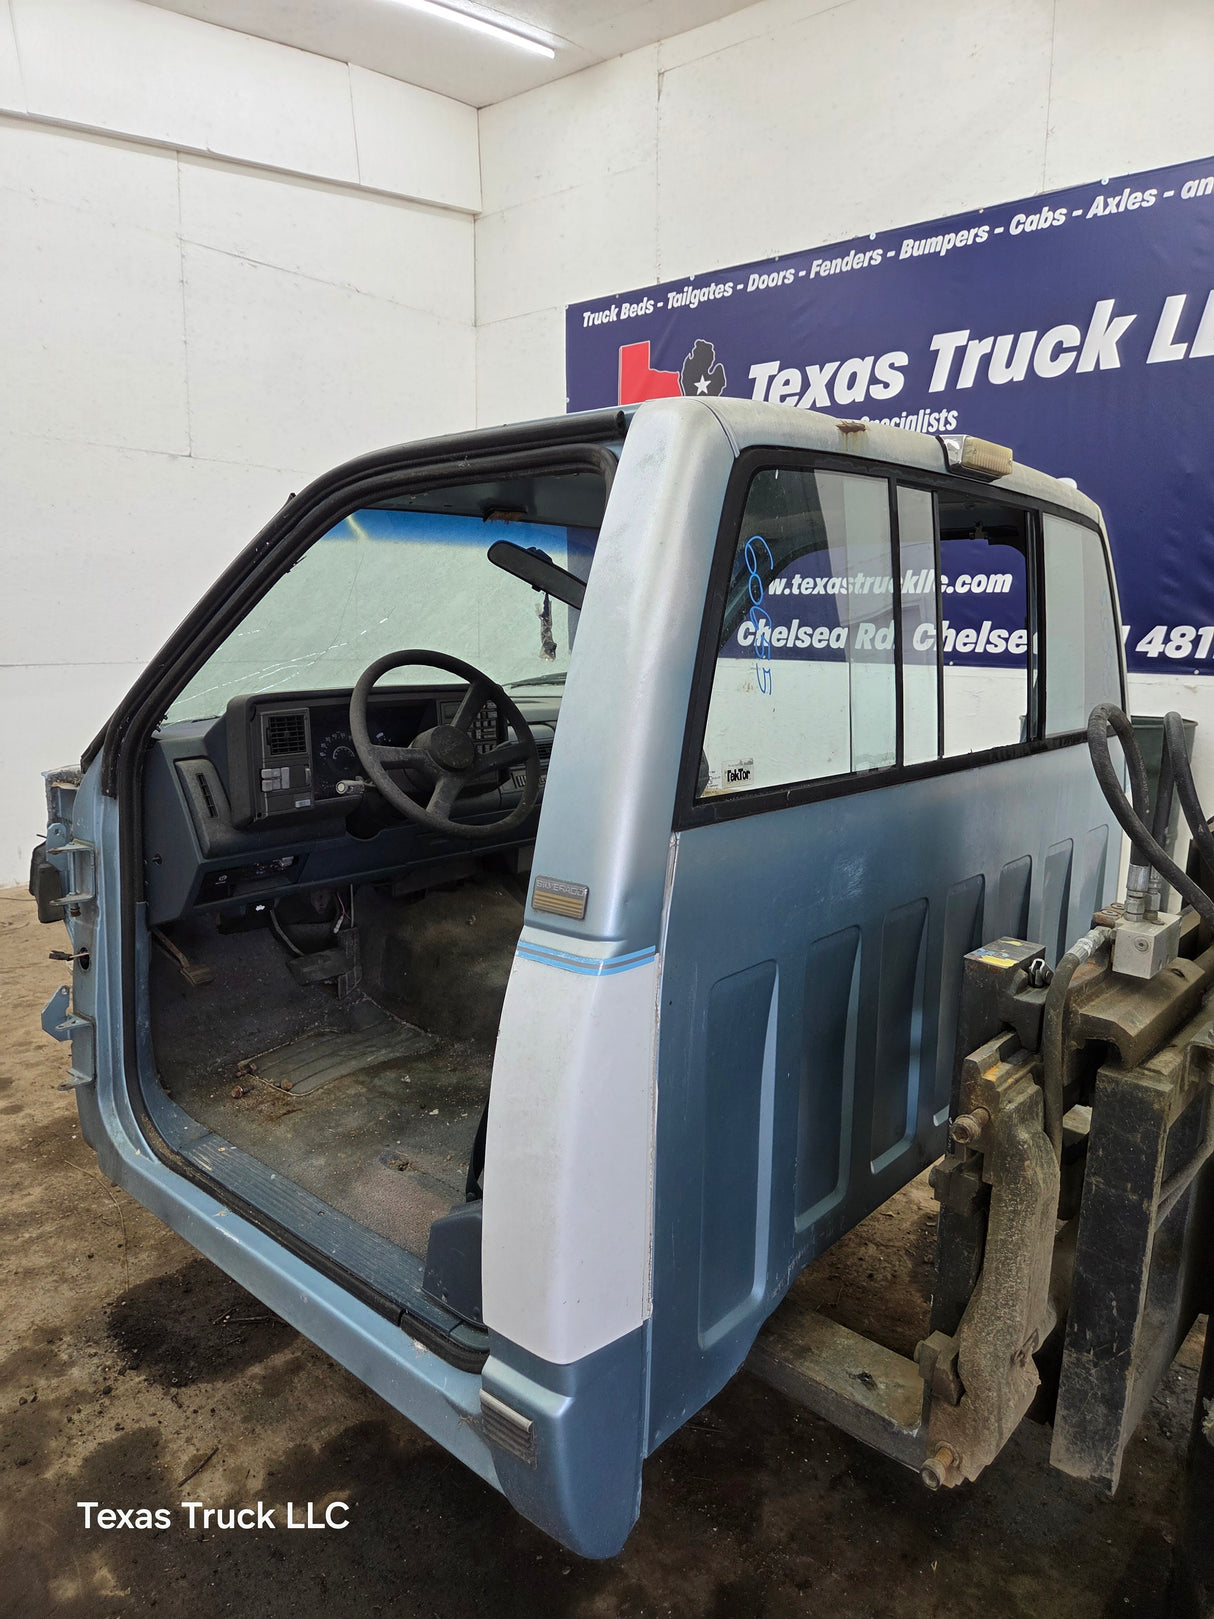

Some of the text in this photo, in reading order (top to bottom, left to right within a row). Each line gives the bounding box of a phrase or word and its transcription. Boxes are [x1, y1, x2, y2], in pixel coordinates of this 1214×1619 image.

[582, 304, 619, 328] Truck
[620, 296, 654, 320] Beds
[667, 282, 733, 309] Tailgates
[747, 268, 795, 291] Doors
[810, 248, 883, 279] Fenders
[899, 224, 989, 260] Bumpers
[1009, 207, 1067, 236] Cabs
[1086, 188, 1158, 219] Axles
[748, 351, 909, 409] Texas
[928, 299, 1138, 393] Truck
[860, 408, 959, 433] cialists
[737, 619, 849, 649] Chelsea
[912, 620, 1028, 654] Chelse
[535, 879, 586, 897] SILVERADO
